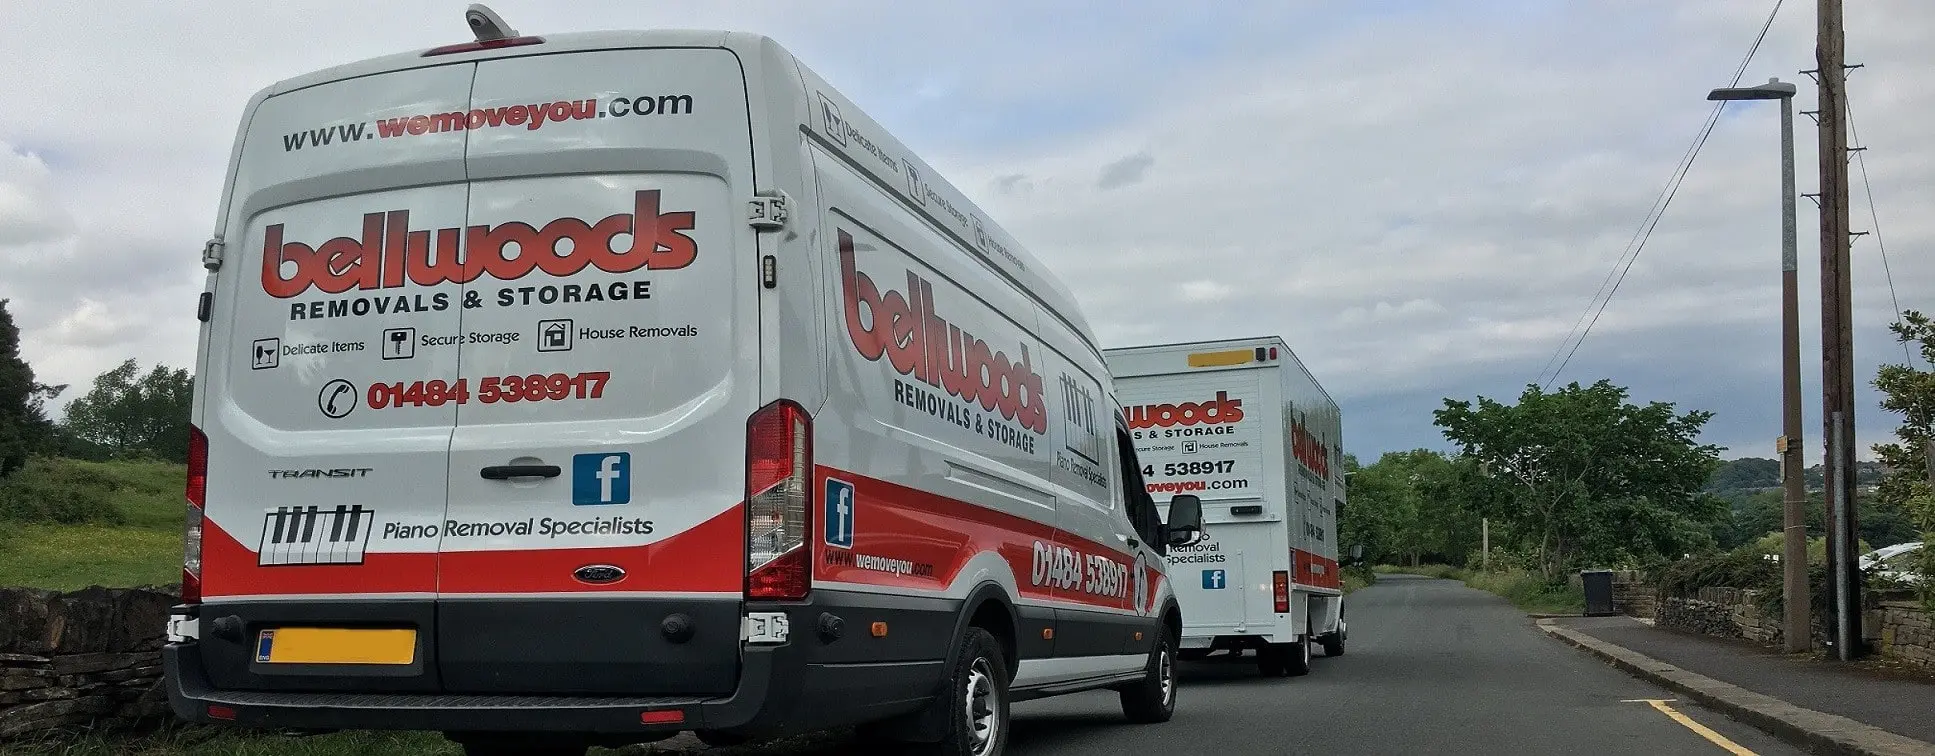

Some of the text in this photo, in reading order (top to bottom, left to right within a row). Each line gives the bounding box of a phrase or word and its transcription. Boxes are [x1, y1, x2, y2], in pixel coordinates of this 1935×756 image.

[283, 94, 693, 152] www.wemoveyou.com
[261, 189, 698, 299] bellwoods
[290, 281, 652, 320] REMOVALS & STORAGE
[421, 329, 520, 346] Secure Storage
[579, 324, 698, 340] House Removals
[837, 227, 1048, 435] bellwoods
[282, 341, 365, 356] Delicate Items
[368, 371, 611, 409] 01484 538917
[894, 379, 1035, 455] REMOVALS & STORAGE
[1124, 391, 1244, 429] woods
[1165, 426, 1235, 438] STORAGE
[1200, 442, 1219, 450] House
[268, 467, 374, 479] TRANSIT
[1164, 460, 1235, 477] 538917
[383, 516, 654, 541] Piano Removal Specialists
[824, 549, 933, 579] www.wemoveyou.com
[1031, 539, 1128, 598] 01484 538917
